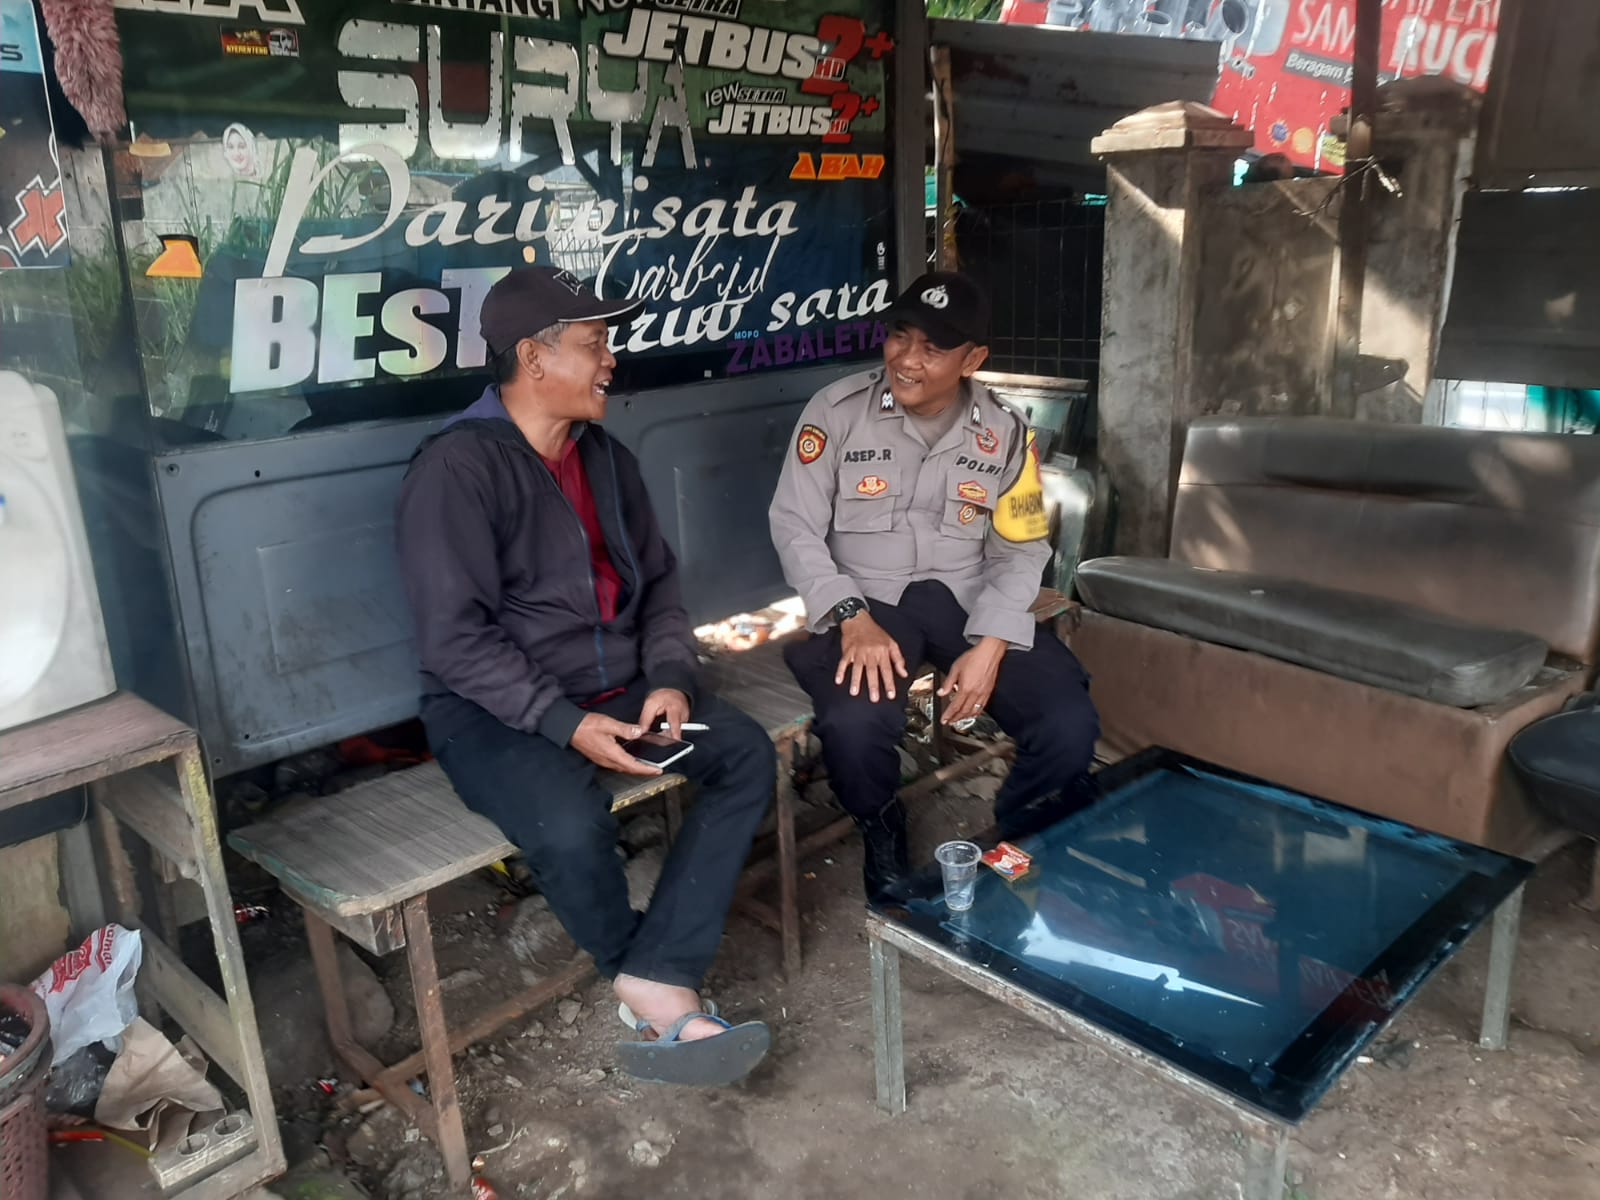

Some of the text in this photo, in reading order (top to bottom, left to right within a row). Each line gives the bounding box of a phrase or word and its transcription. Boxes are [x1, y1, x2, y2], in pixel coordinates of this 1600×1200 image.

[603, 8, 820, 79] JETBUS
[1285, 53, 1345, 78] Beragam
[337, 18, 698, 170] SURYA
[708, 103, 833, 135] JETBUS
[725, 320, 889, 374] ZABALETA
[956, 455, 1002, 476] POLRI
